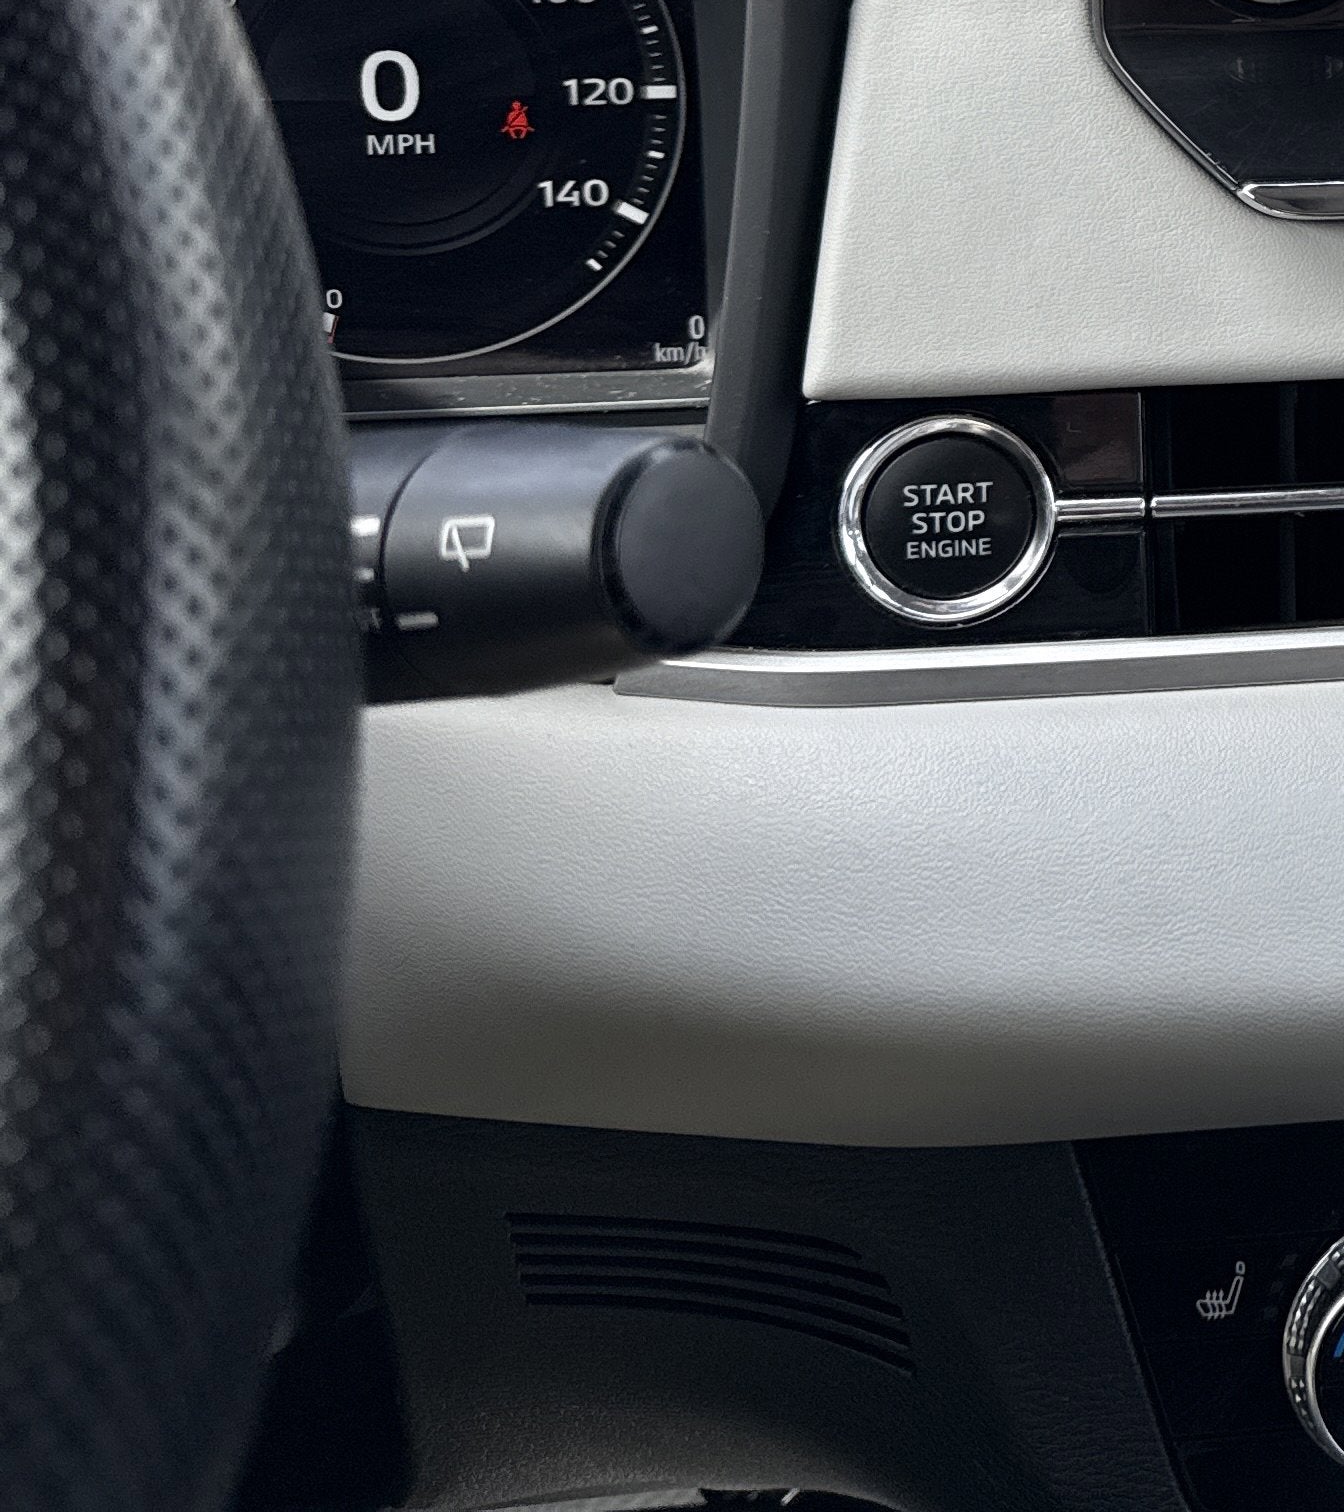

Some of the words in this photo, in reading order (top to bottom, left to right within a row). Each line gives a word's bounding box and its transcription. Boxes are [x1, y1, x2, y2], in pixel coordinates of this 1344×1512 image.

[360, 50, 420, 121] 0
[562, 78, 634, 105] 120
[366, 134, 436, 155] MPH
[537, 180, 610, 206] 140
[689, 315, 705, 339] 0
[655, 342, 707, 365] km/h
[903, 481, 994, 508] START
[911, 510, 986, 535] STOP
[906, 538, 992, 560] ENGINE
